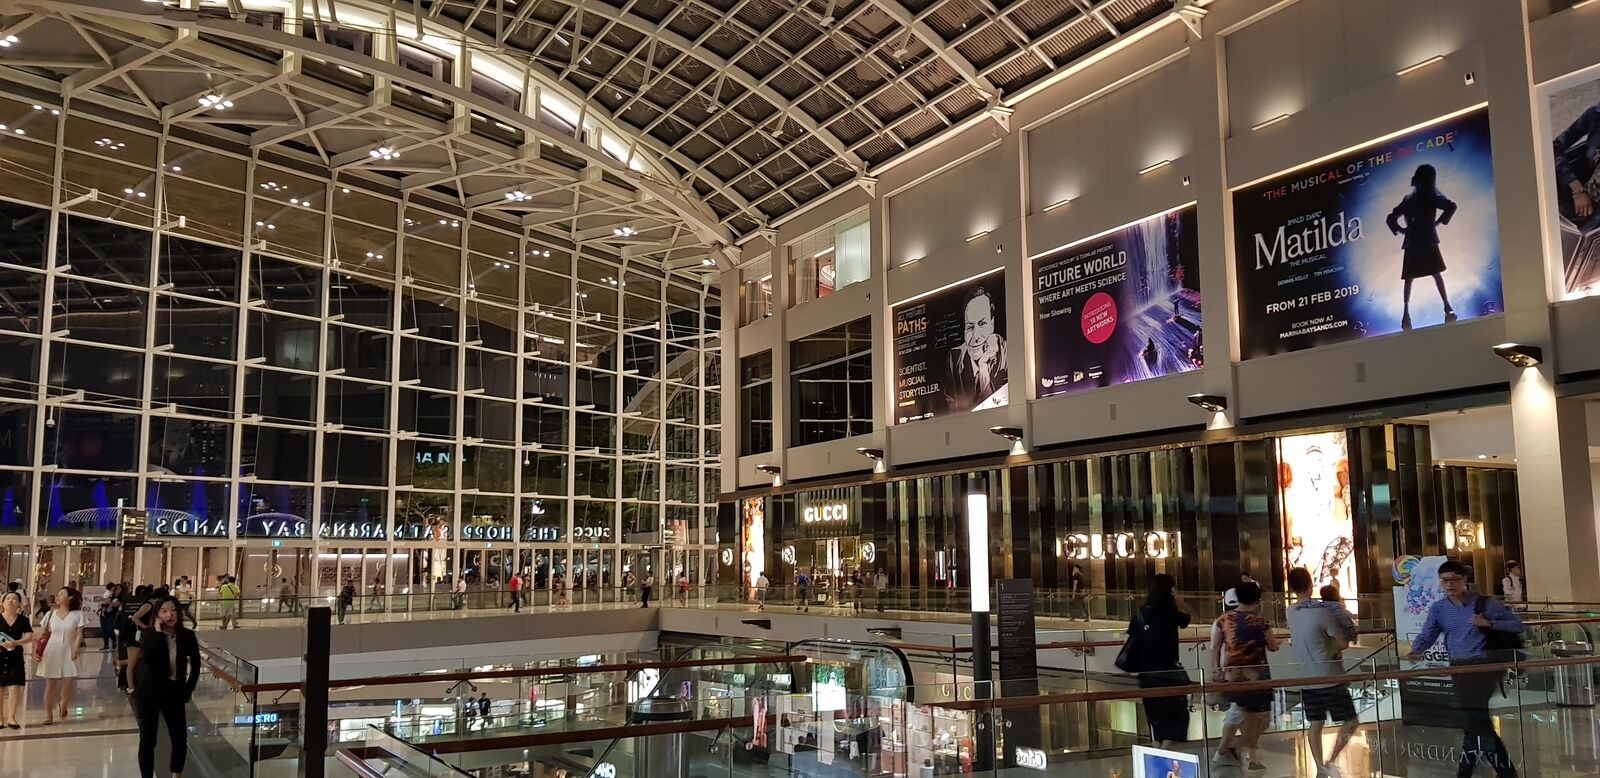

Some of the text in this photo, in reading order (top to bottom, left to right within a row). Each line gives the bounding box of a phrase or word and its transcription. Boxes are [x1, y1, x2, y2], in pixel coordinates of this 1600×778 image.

[1291, 169, 1342, 193] MUSICAL
[1347, 161, 1364, 175] OF
[1368, 152, 1392, 168] THE
[1254, 211, 1364, 271] Matilda
[1301, 254, 1327, 264] MUSICAL
[1038, 251, 1127, 290] FUTURE WORLD
[1039, 272, 1126, 304] WHERE ART MEETS SCIENCE
[1277, 277, 1294, 286] DENNIS
[1295, 273, 1309, 282] KELLY
[1266, 285, 1360, 314] FROM 21 FEB 2019
[1039, 307, 1072, 320] Now Showing
[1097, 310, 1108, 321] NEW
[897, 317, 927, 334] PATHS
[1086, 316, 1114, 335] ARTWORKS
[1279, 320, 1348, 339] MARINABAYSANDS.COM
[1292, 320, 1309, 329] BOOK
[1310, 317, 1325, 326] NOW
[899, 361, 928, 376] SCIENTIST.
[899, 383, 940, 400] STORYTELLER.
[804, 504, 848, 522] GUCCI
